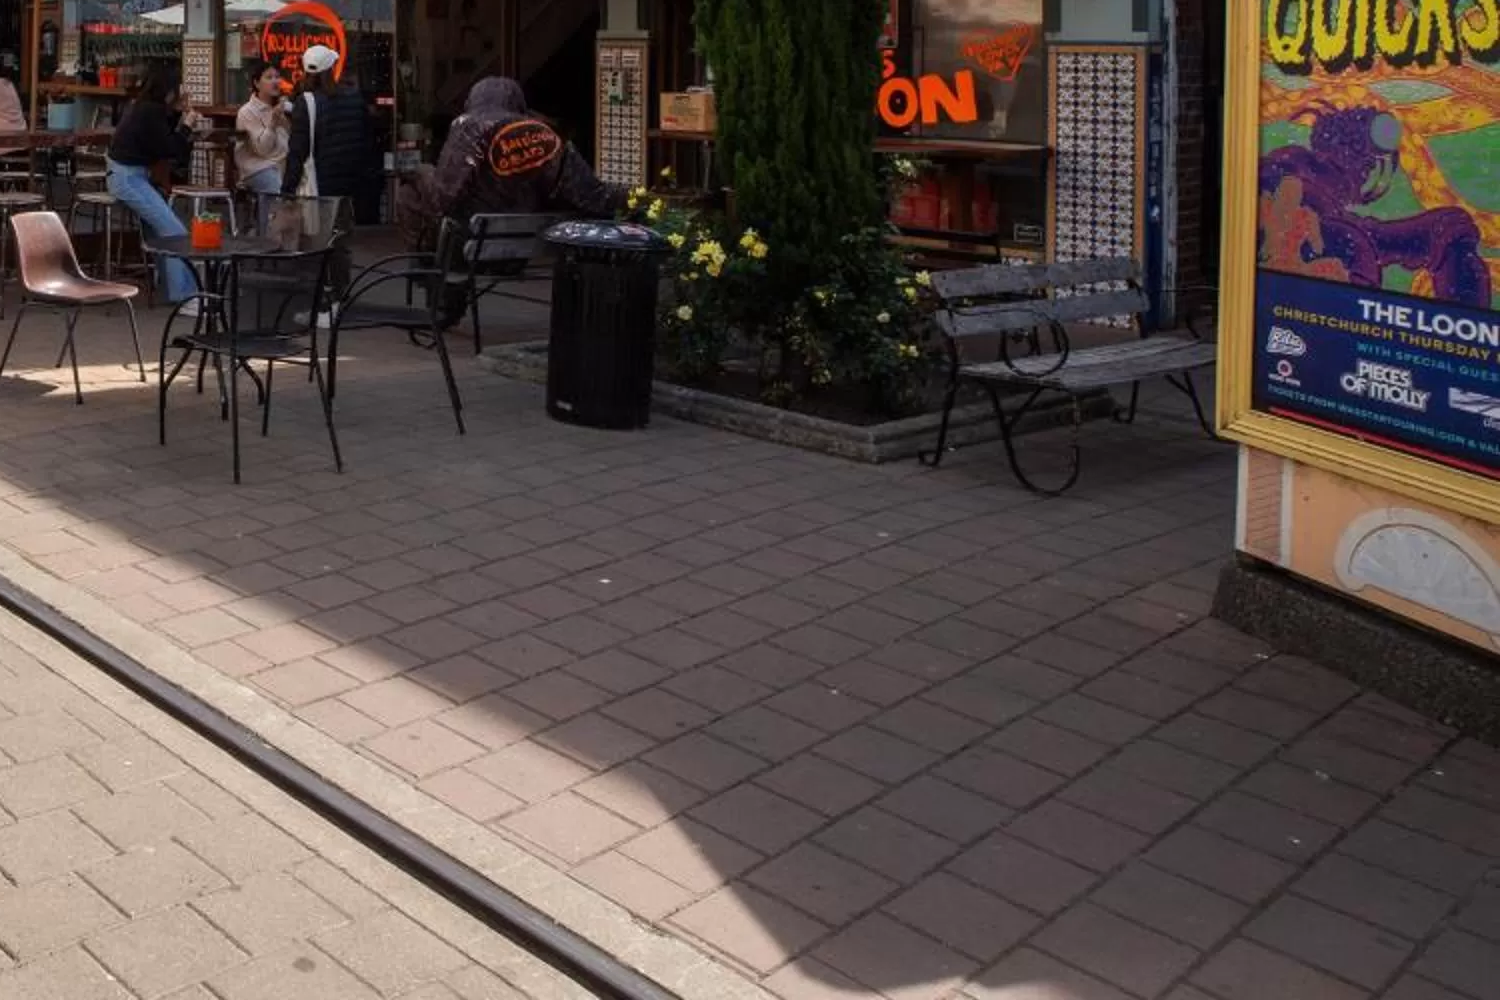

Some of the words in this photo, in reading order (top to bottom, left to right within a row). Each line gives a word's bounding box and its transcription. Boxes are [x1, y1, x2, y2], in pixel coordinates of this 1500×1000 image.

[1357, 299, 1413, 329] THE
[1273, 306, 1394, 341] CHRISTCHURCH
[1399, 331, 1491, 361] THURSDAY
[1356, 341, 1391, 357] WITH
[1396, 352, 1453, 373] SPECIAL
[1358, 360, 1412, 386] PIECES
[1340, 373, 1368, 394] OF
[1370, 382, 1430, 411] MOLLY
